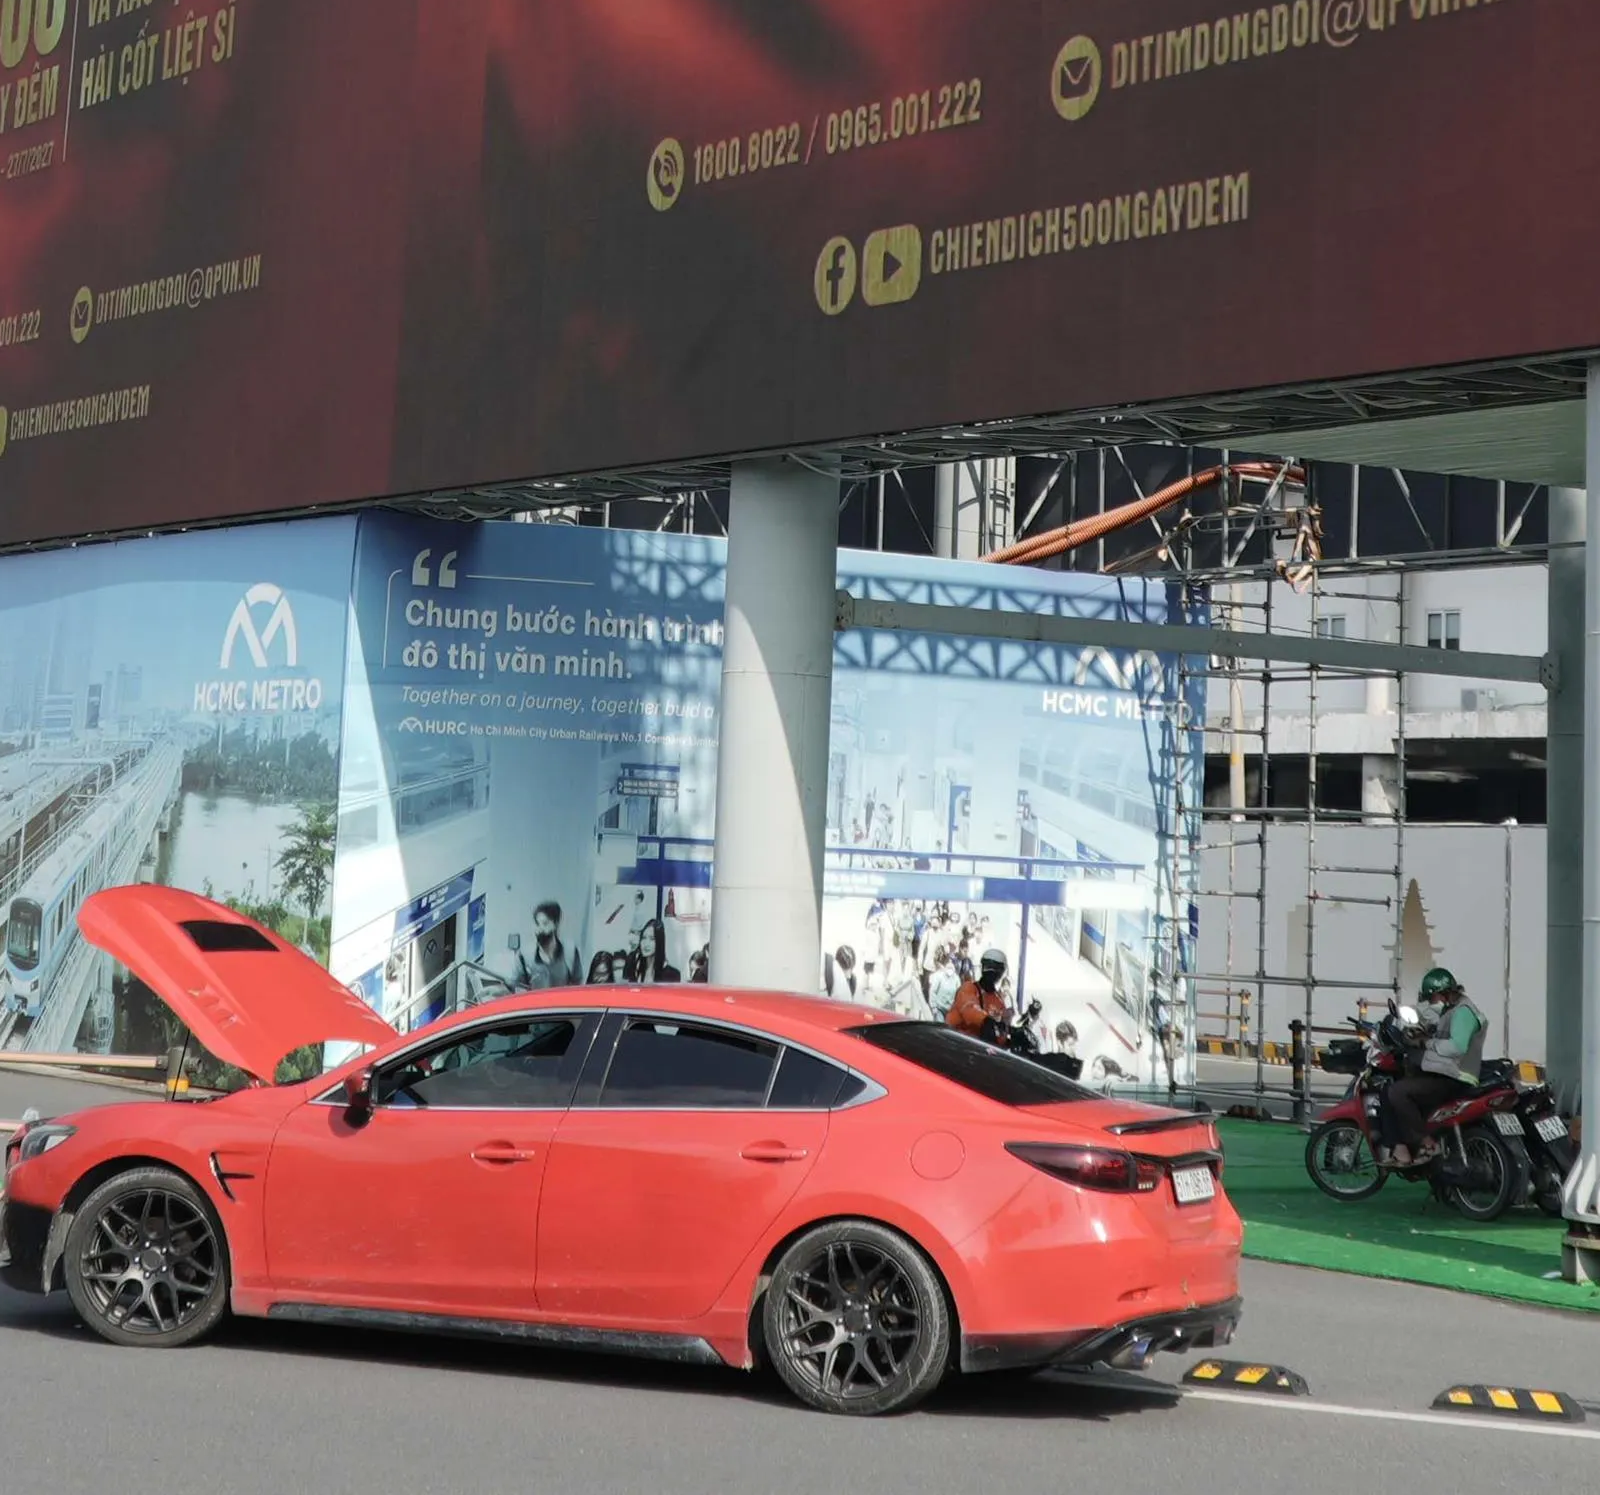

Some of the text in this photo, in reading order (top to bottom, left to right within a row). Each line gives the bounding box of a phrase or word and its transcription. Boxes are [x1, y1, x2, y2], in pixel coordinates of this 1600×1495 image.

[79, 41, 113, 110] HÀI
[119, 21, 160, 90] CỐT
[162, 6, 208, 85] LIỆT
[14, 59, 60, 131] ĐÊM
[693, 122, 801, 185] 1800.8022
[825, 77, 982, 155] 0965.001.222
[405, 599, 724, 647] Chung bước hành trình
[402, 639, 633, 680] đô thị văn minh.
[194, 678, 322, 712] HCMC METRO
[402, 684, 478, 709] Together
[480, 693, 501, 707] on
[505, 695, 517, 709] a
[519, 693, 586, 715] journey,
[590, 696, 660, 721] together
[1042, 691, 1108, 717] HCMC
[425, 721, 467, 735] HURC
[485, 725, 501, 736] Chi
[503, 726, 526, 737] Minh
[529, 727, 548, 740] City
[549, 728, 577, 741] Urban
[579, 729, 620, 744] Railways
[621, 732, 642, 744] No.1
